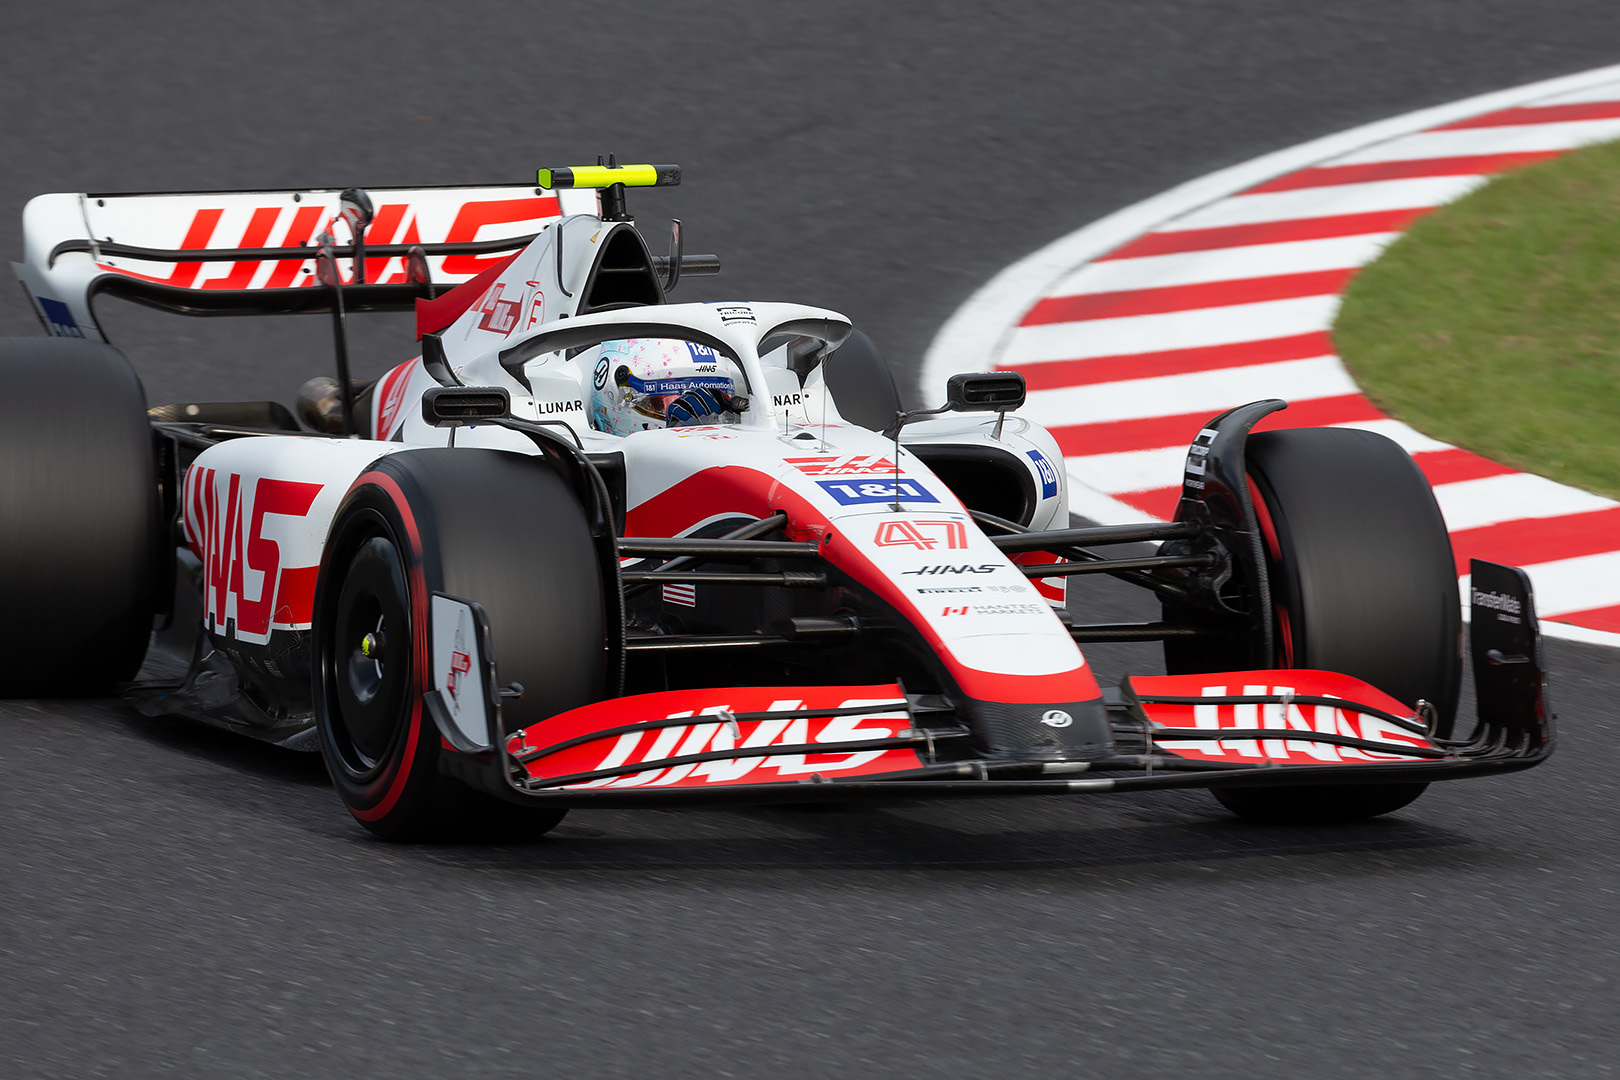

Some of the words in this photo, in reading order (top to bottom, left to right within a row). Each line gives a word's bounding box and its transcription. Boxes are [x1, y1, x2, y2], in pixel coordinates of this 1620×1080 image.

[110, 196, 562, 290] HAAS
[688, 342, 713, 356] 1&1
[660, 383, 687, 391] Haas
[774, 394, 801, 406] NAR
[538, 400, 583, 415] LUNAR
[816, 467, 892, 475] HAAS
[1034, 458, 1056, 485] 1&1
[828, 483, 923, 498] 1&1
[873, 520, 969, 550] 47
[901, 564, 1005, 576] HAAS
[916, 586, 983, 594] PIRELLI
[550, 699, 908, 789] HAAS
